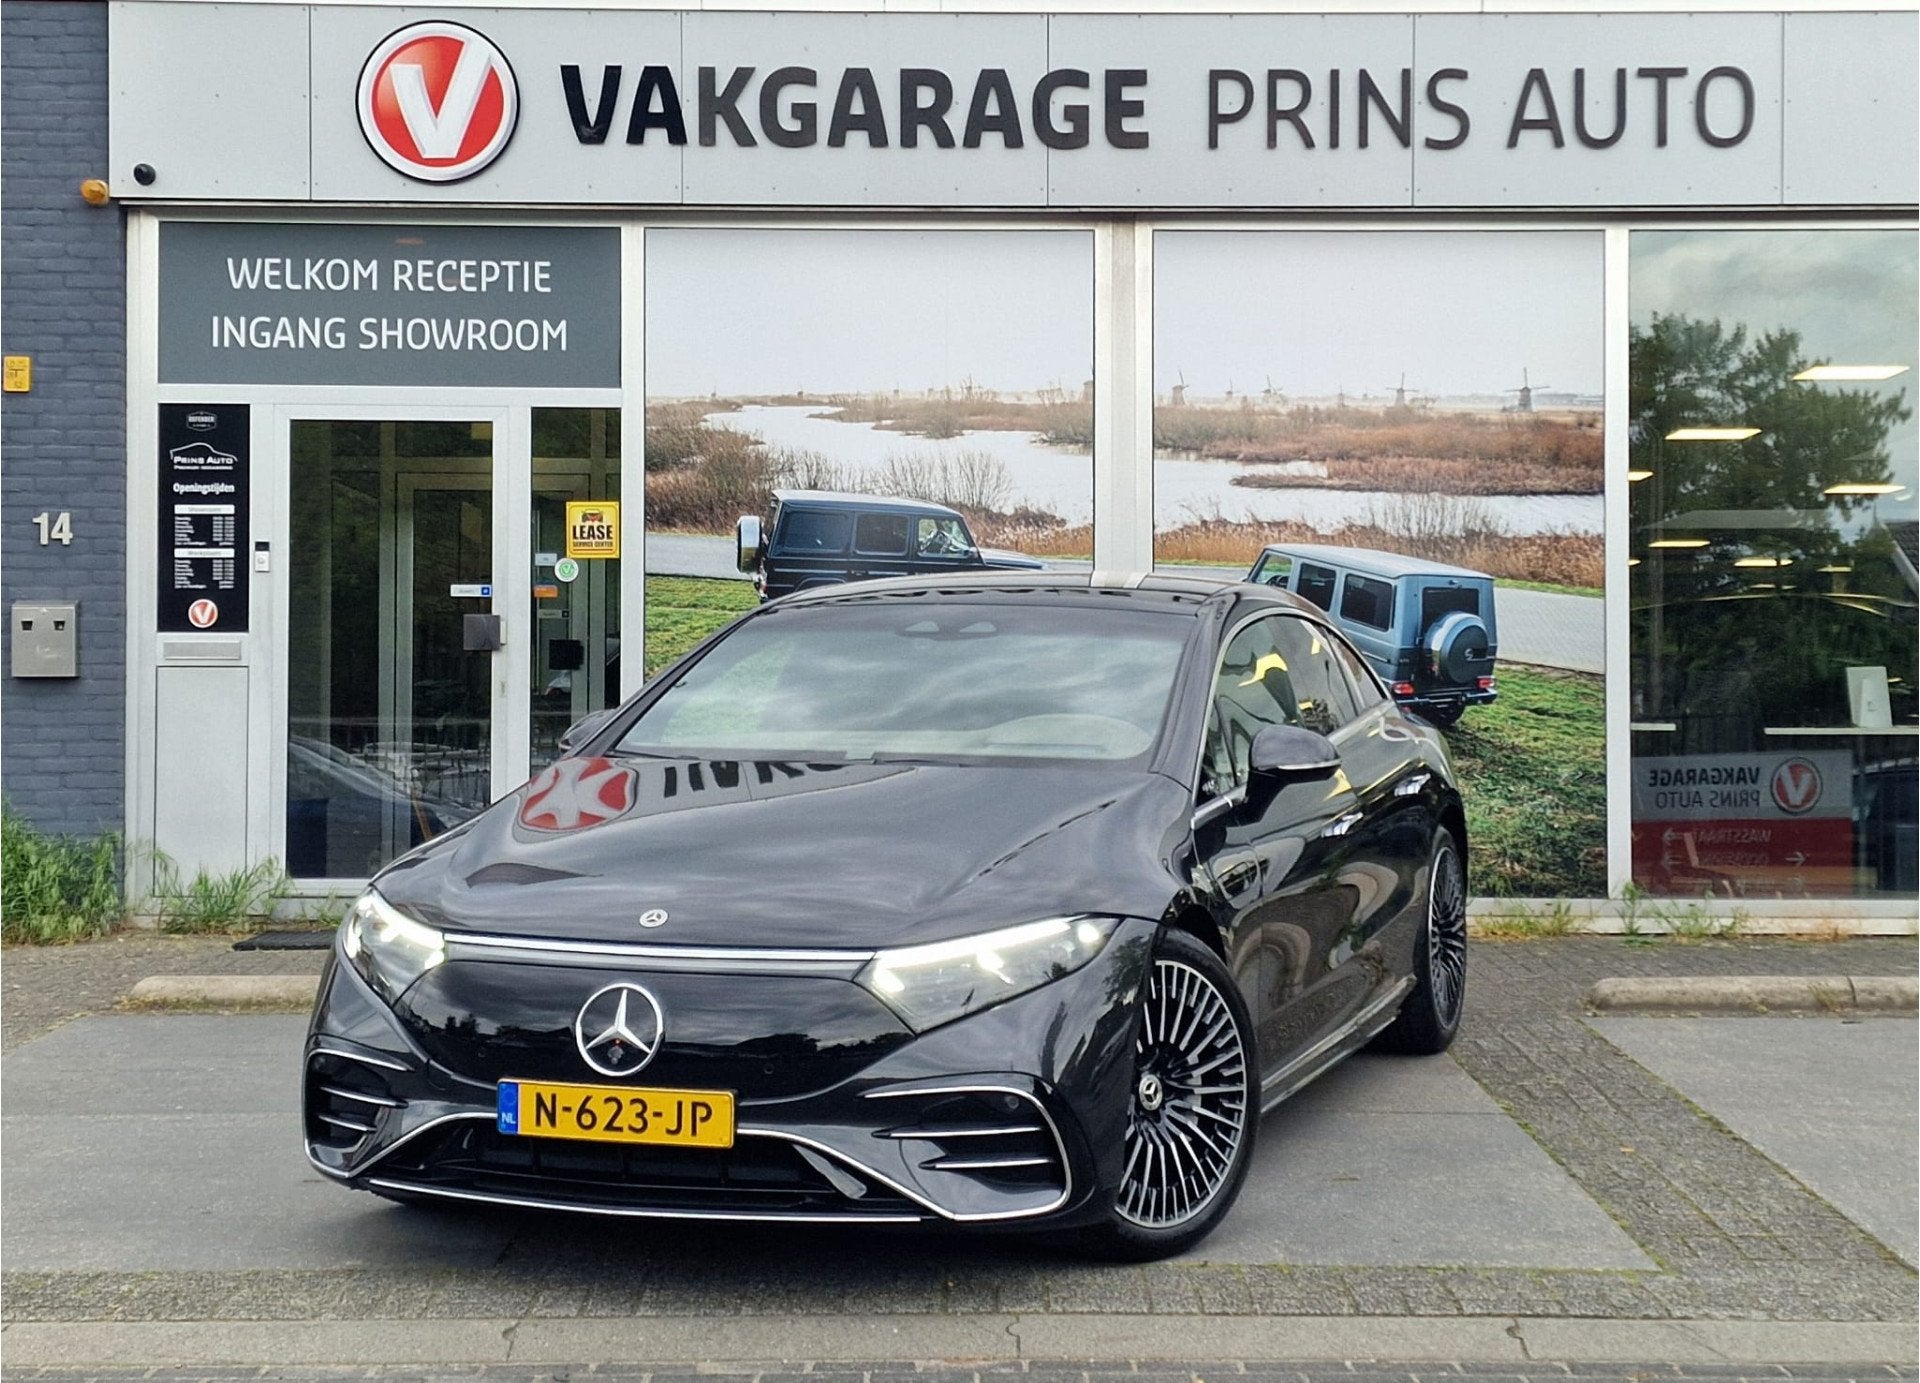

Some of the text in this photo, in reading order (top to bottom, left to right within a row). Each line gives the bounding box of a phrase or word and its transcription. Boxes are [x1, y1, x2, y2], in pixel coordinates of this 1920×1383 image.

[560, 64, 1756, 151] VAKGARAGE PRINS AUTO
[227, 257, 553, 293] WELKOM RECEPTIE
[211, 315, 568, 351] INGANG SHOWROOM
[173, 482, 235, 495] Openingstijden
[32, 511, 73, 546] 14
[572, 525, 614, 540] LEASE
[501, 1112, 516, 1125] NL
[534, 1092, 713, 1137] N-623-JP
